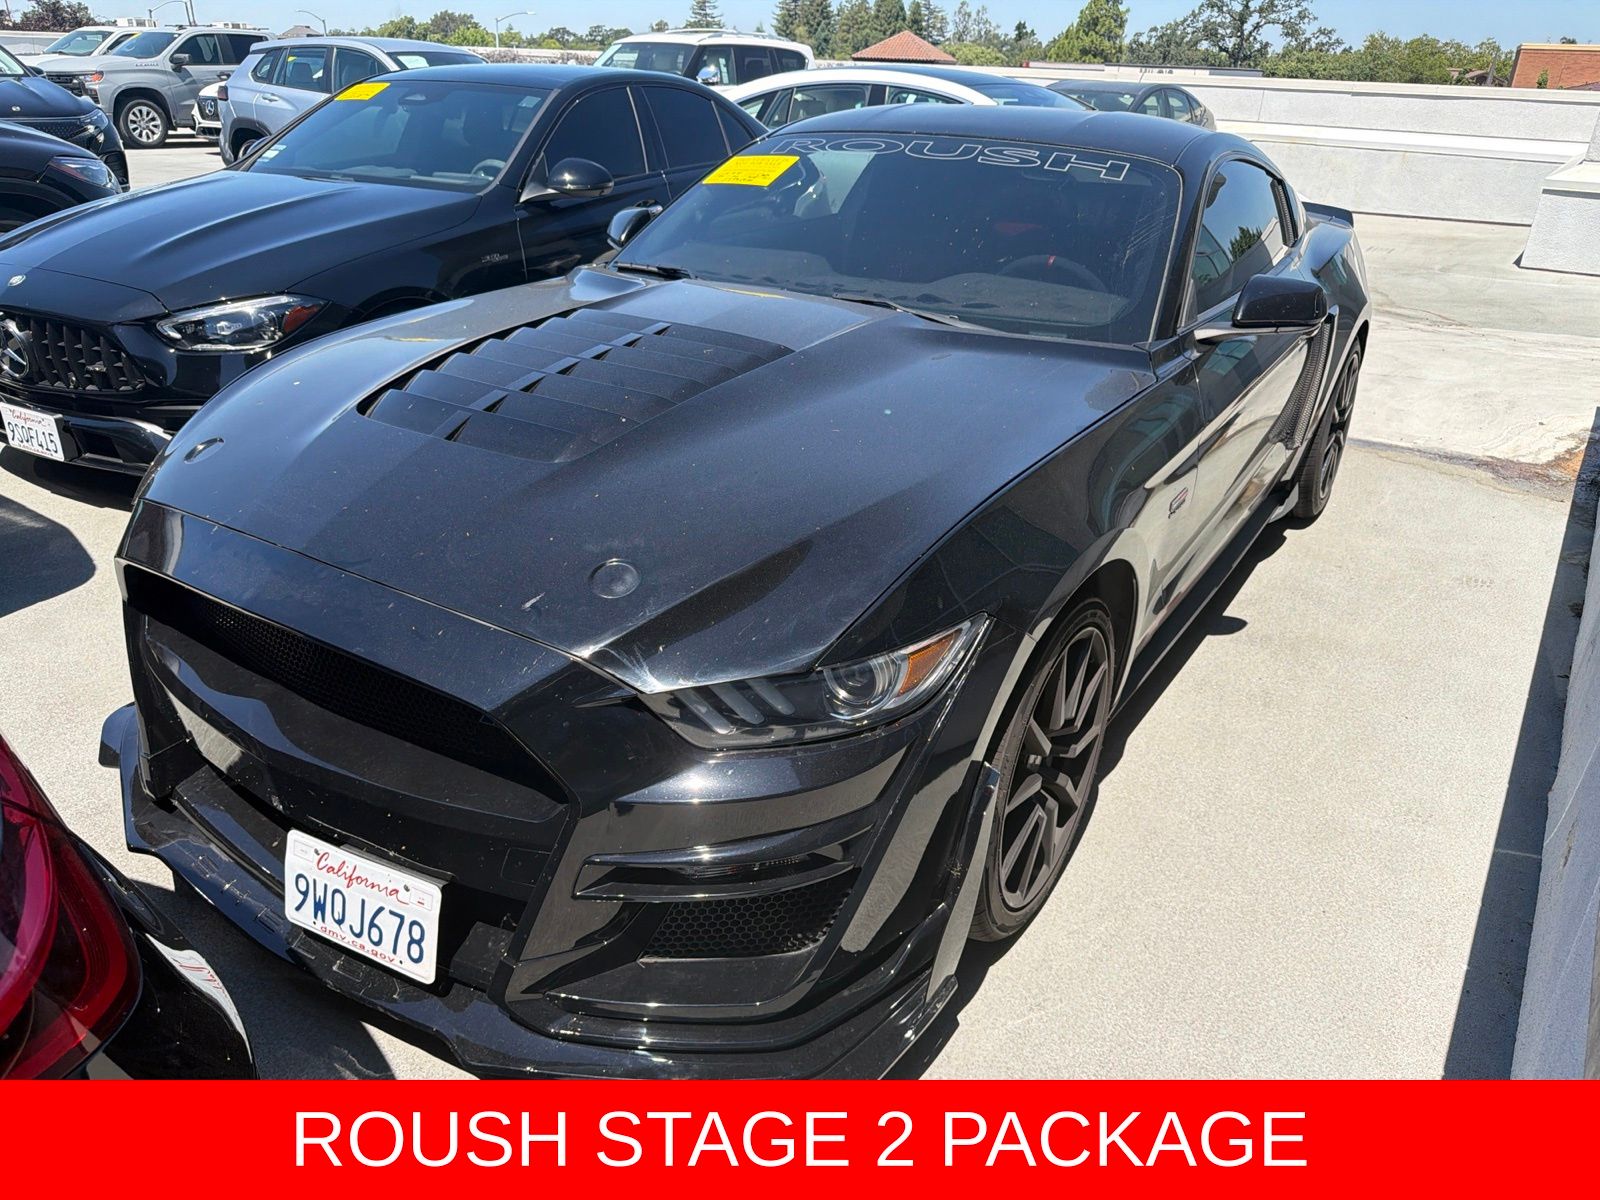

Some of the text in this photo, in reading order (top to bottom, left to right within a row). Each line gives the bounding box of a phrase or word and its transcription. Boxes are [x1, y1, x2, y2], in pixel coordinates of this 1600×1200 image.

[771, 138, 1131, 182] ROUSH
[11, 409, 47, 427] California
[315, 851, 410, 906] California
[294, 873, 426, 964] 9WQJ678
[319, 924, 396, 964] dmv.ca.gov
